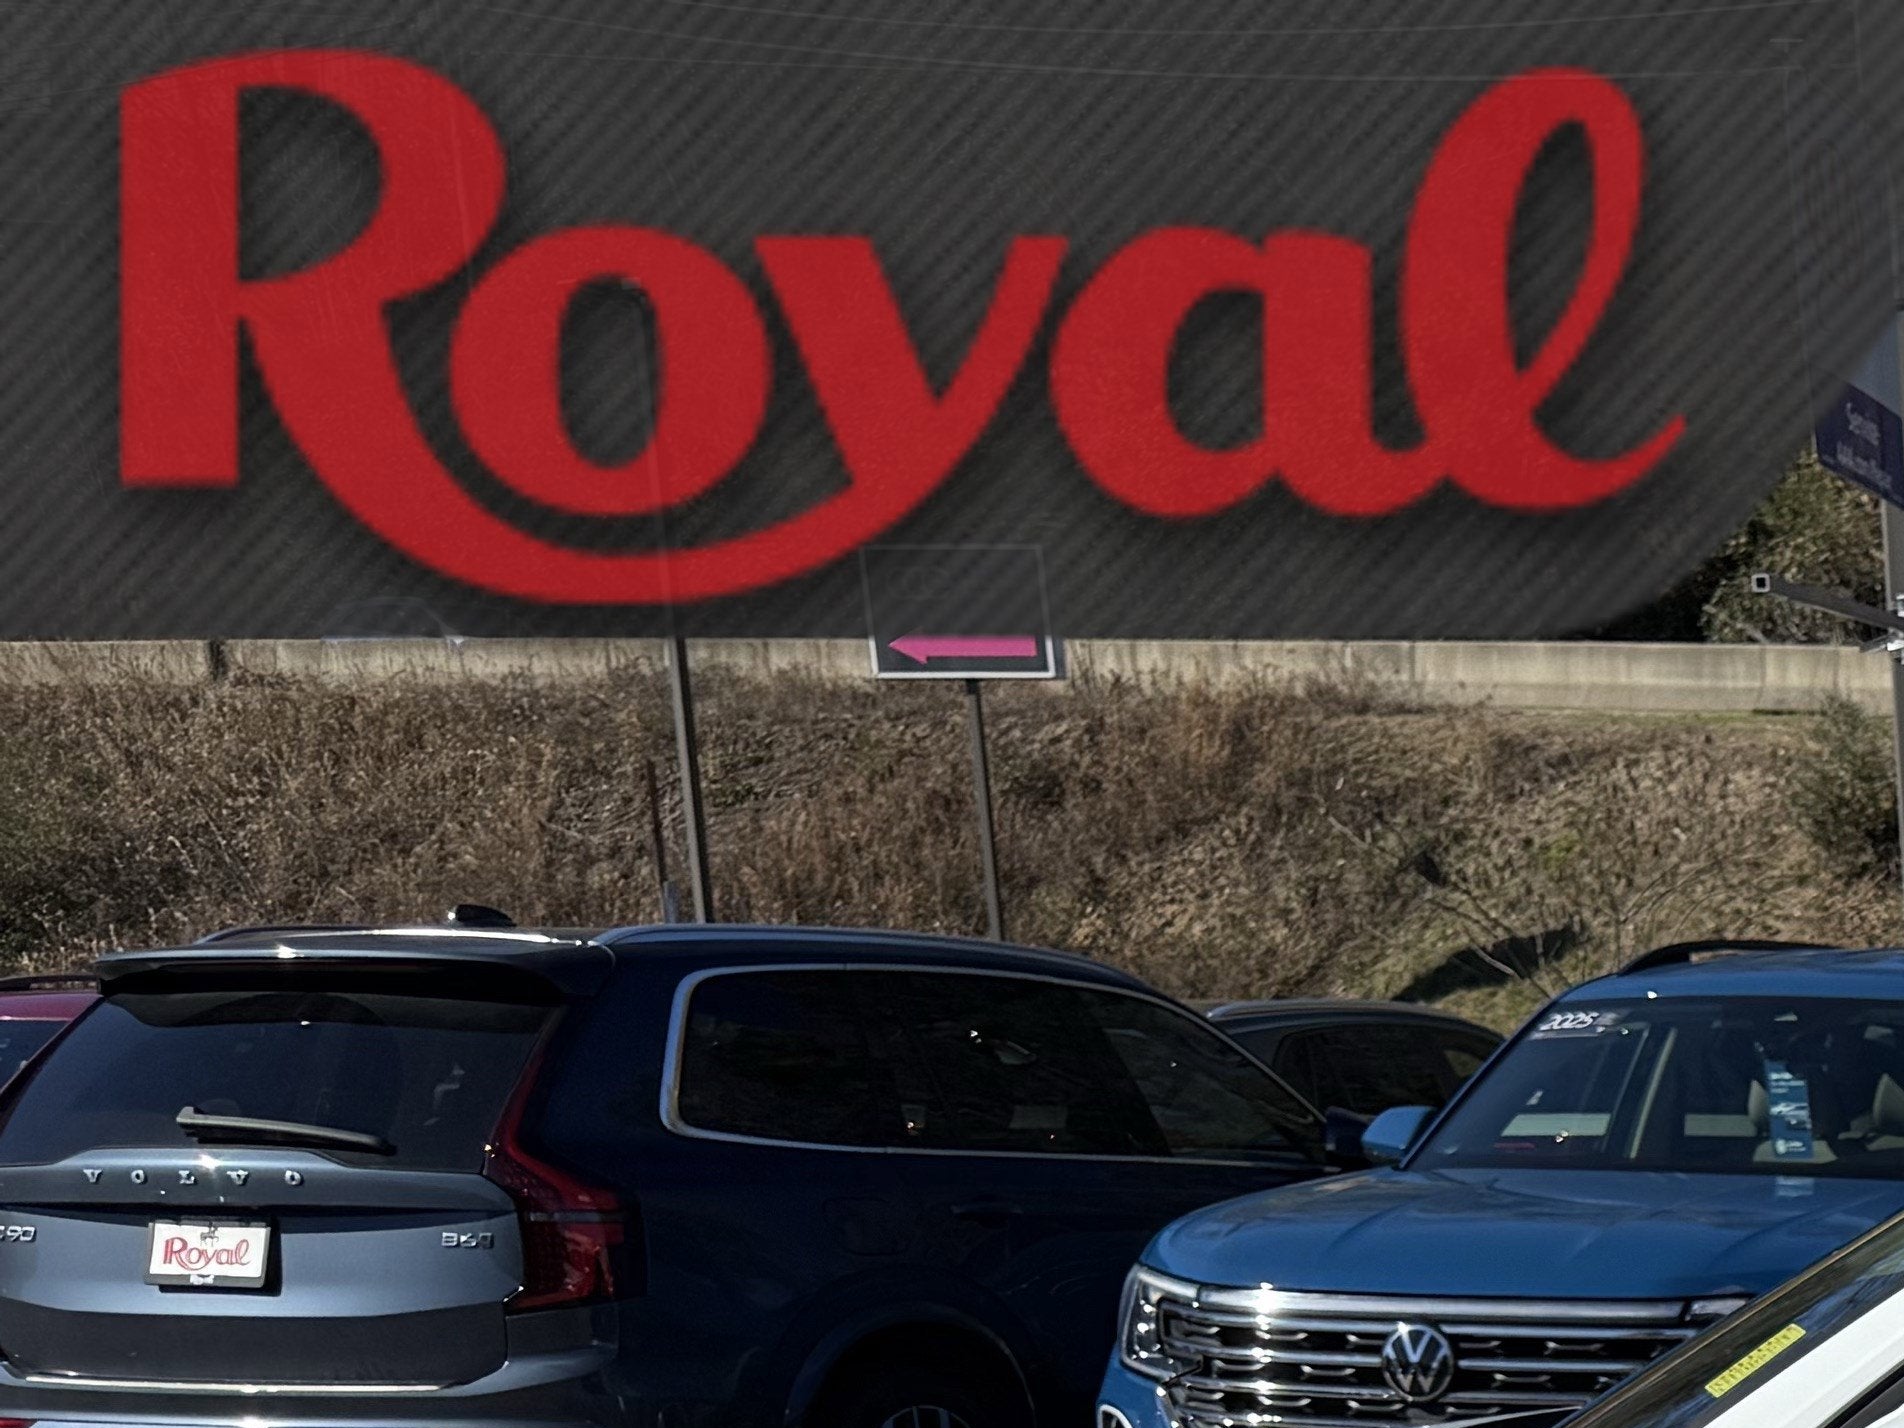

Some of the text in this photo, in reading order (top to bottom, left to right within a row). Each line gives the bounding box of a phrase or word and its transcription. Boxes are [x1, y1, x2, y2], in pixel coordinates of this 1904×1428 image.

[1540, 1010, 1600, 1032] 2025
[83, 1168, 304, 1188] VOLVO
[163, 1236, 251, 1271] Royal
